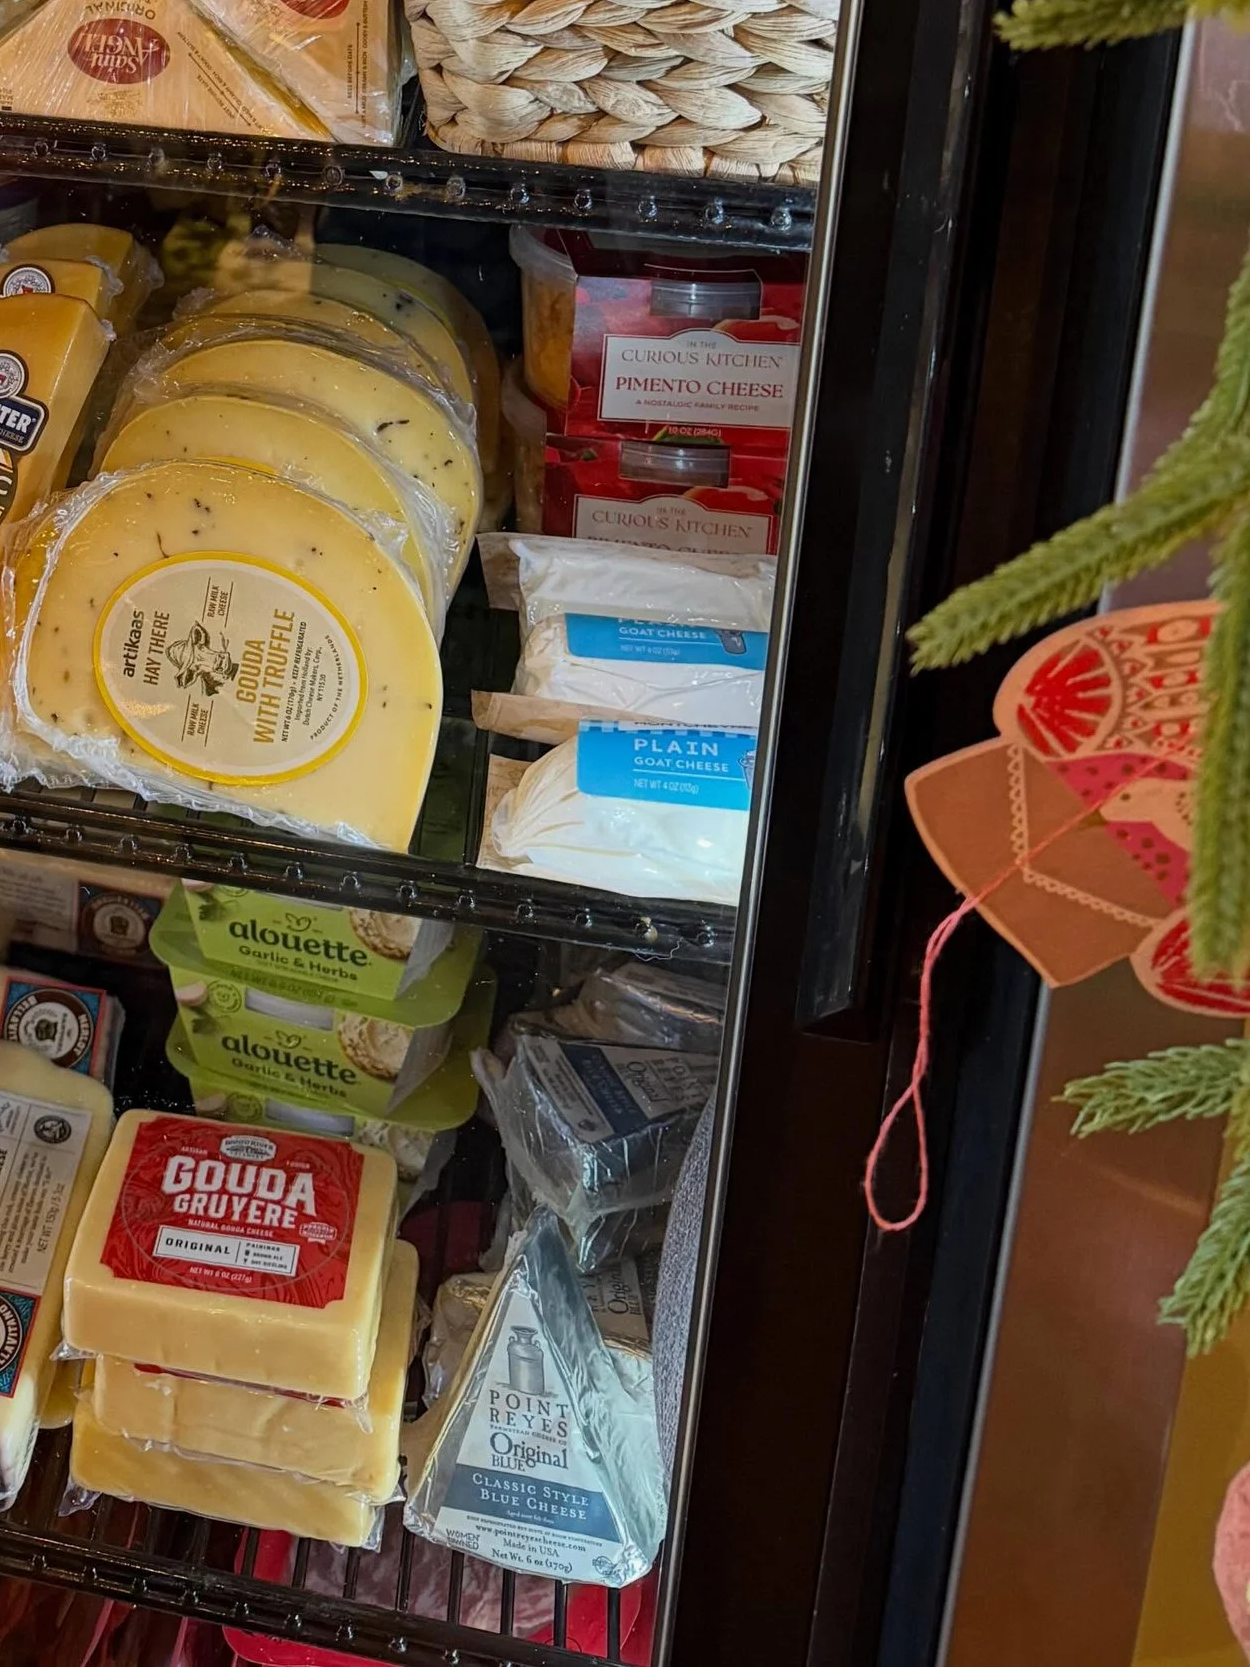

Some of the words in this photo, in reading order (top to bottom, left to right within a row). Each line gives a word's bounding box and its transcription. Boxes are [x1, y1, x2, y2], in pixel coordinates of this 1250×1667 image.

[621, 348, 699, 366] CURIOUS
[705, 353, 782, 368] KITCHEN
[615, 376, 701, 394] PIMENTO
[707, 380, 784, 398] CHEESE
[123, 609, 145, 677] artikaas
[146, 610, 170, 654] THERE
[263, 608, 295, 689] TRUFFLE
[143, 658, 158, 685] HAY
[236, 638, 266, 704] GOUDA
[253, 695, 275, 744] WITH
[634, 738, 719, 756] PLAIN
[634, 756, 671, 768] GOAT
[675, 759, 730, 773] CHEESE
[229, 918, 368, 967] alouette
[239, 945, 289, 965] Garlic
[293, 957, 305, 968] &
[308, 961, 358, 981] Herbs
[161, 1154, 317, 1217] GOUDA
[173, 1193, 298, 1229] GRUYERE
[165, 1237, 231, 1255] ORIGINAL
[490, 1389, 568, 1419] POINT
[490, 1407, 568, 1438] REYES
[490, 1431, 569, 1470] Original
[492, 1453, 526, 1472] BLUE
[472, 1472, 537, 1494] CLASSIC
[543, 1486, 589, 1507] STYLE
[480, 1487, 520, 1507] BLUE
[526, 1497, 587, 1521] CHEESE
